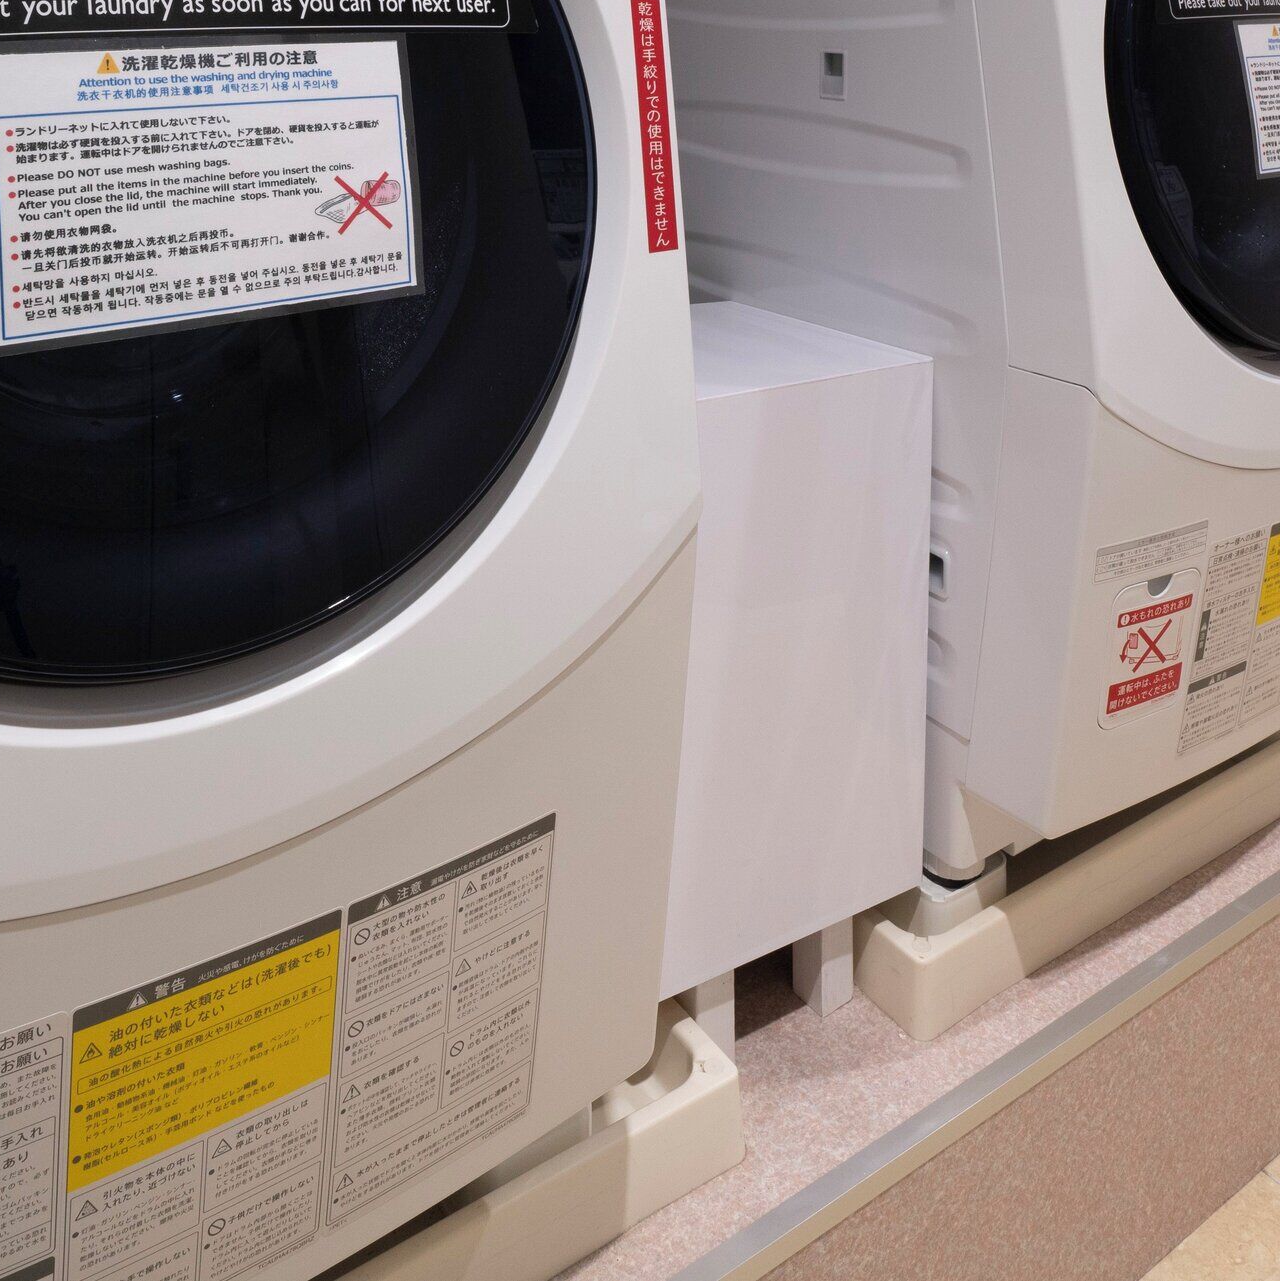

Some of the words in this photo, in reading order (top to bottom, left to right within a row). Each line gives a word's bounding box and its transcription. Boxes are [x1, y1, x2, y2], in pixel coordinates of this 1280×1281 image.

[122, 50, 318, 72] 洗濯乾燥機ご利用の注意
[79, 77, 131, 87] Attention
[149, 76, 167, 84] use
[170, 74, 188, 82] the
[191, 72, 234, 83] washing
[238, 71, 256, 80] and
[259, 70, 290, 81] drying
[292, 69, 332, 78] machine
[221, 82, 269, 93] 세탁건조기
[271, 81, 289, 91] 사용
[292, 81, 300, 90] 시
[303, 80, 338, 90] 주의사항
[15, 114, 231, 137] ランドリーネットに入れて使用しないで下さい。
[638, 1, 670, 247] 乾燥は手絞りでの使用はできません
[17, 174, 54, 182] Please
[58, 171, 74, 179] DO
[78, 168, 101, 177] NOT
[104, 167, 123, 175] use
[126, 164, 155, 173] mesh
[158, 160, 201, 170] washing
[204, 158, 230, 169] bags.
[18, 189, 54, 198] Please
[58, 186, 77, 196] put
[80, 184, 93, 192] all
[96, 183, 115, 191] the
[118, 180, 147, 189] items
[163, 177, 180, 186] the
[183, 173, 225, 183] machine
[229, 169, 260, 180] before
[263, 169, 280, 179] you
[282, 166, 309, 175] insert
[312, 164, 326, 172] the
[329, 162, 354, 171] coins.
[70, 273, 110, 286] 사용하지
[1131, 598, 1190, 622] 水もれの恐れあり
[396, 882, 423, 901] 注意
[154, 978, 186, 1000] 警告
[108, 1004, 225, 1060] 絶対に乾燥しない
